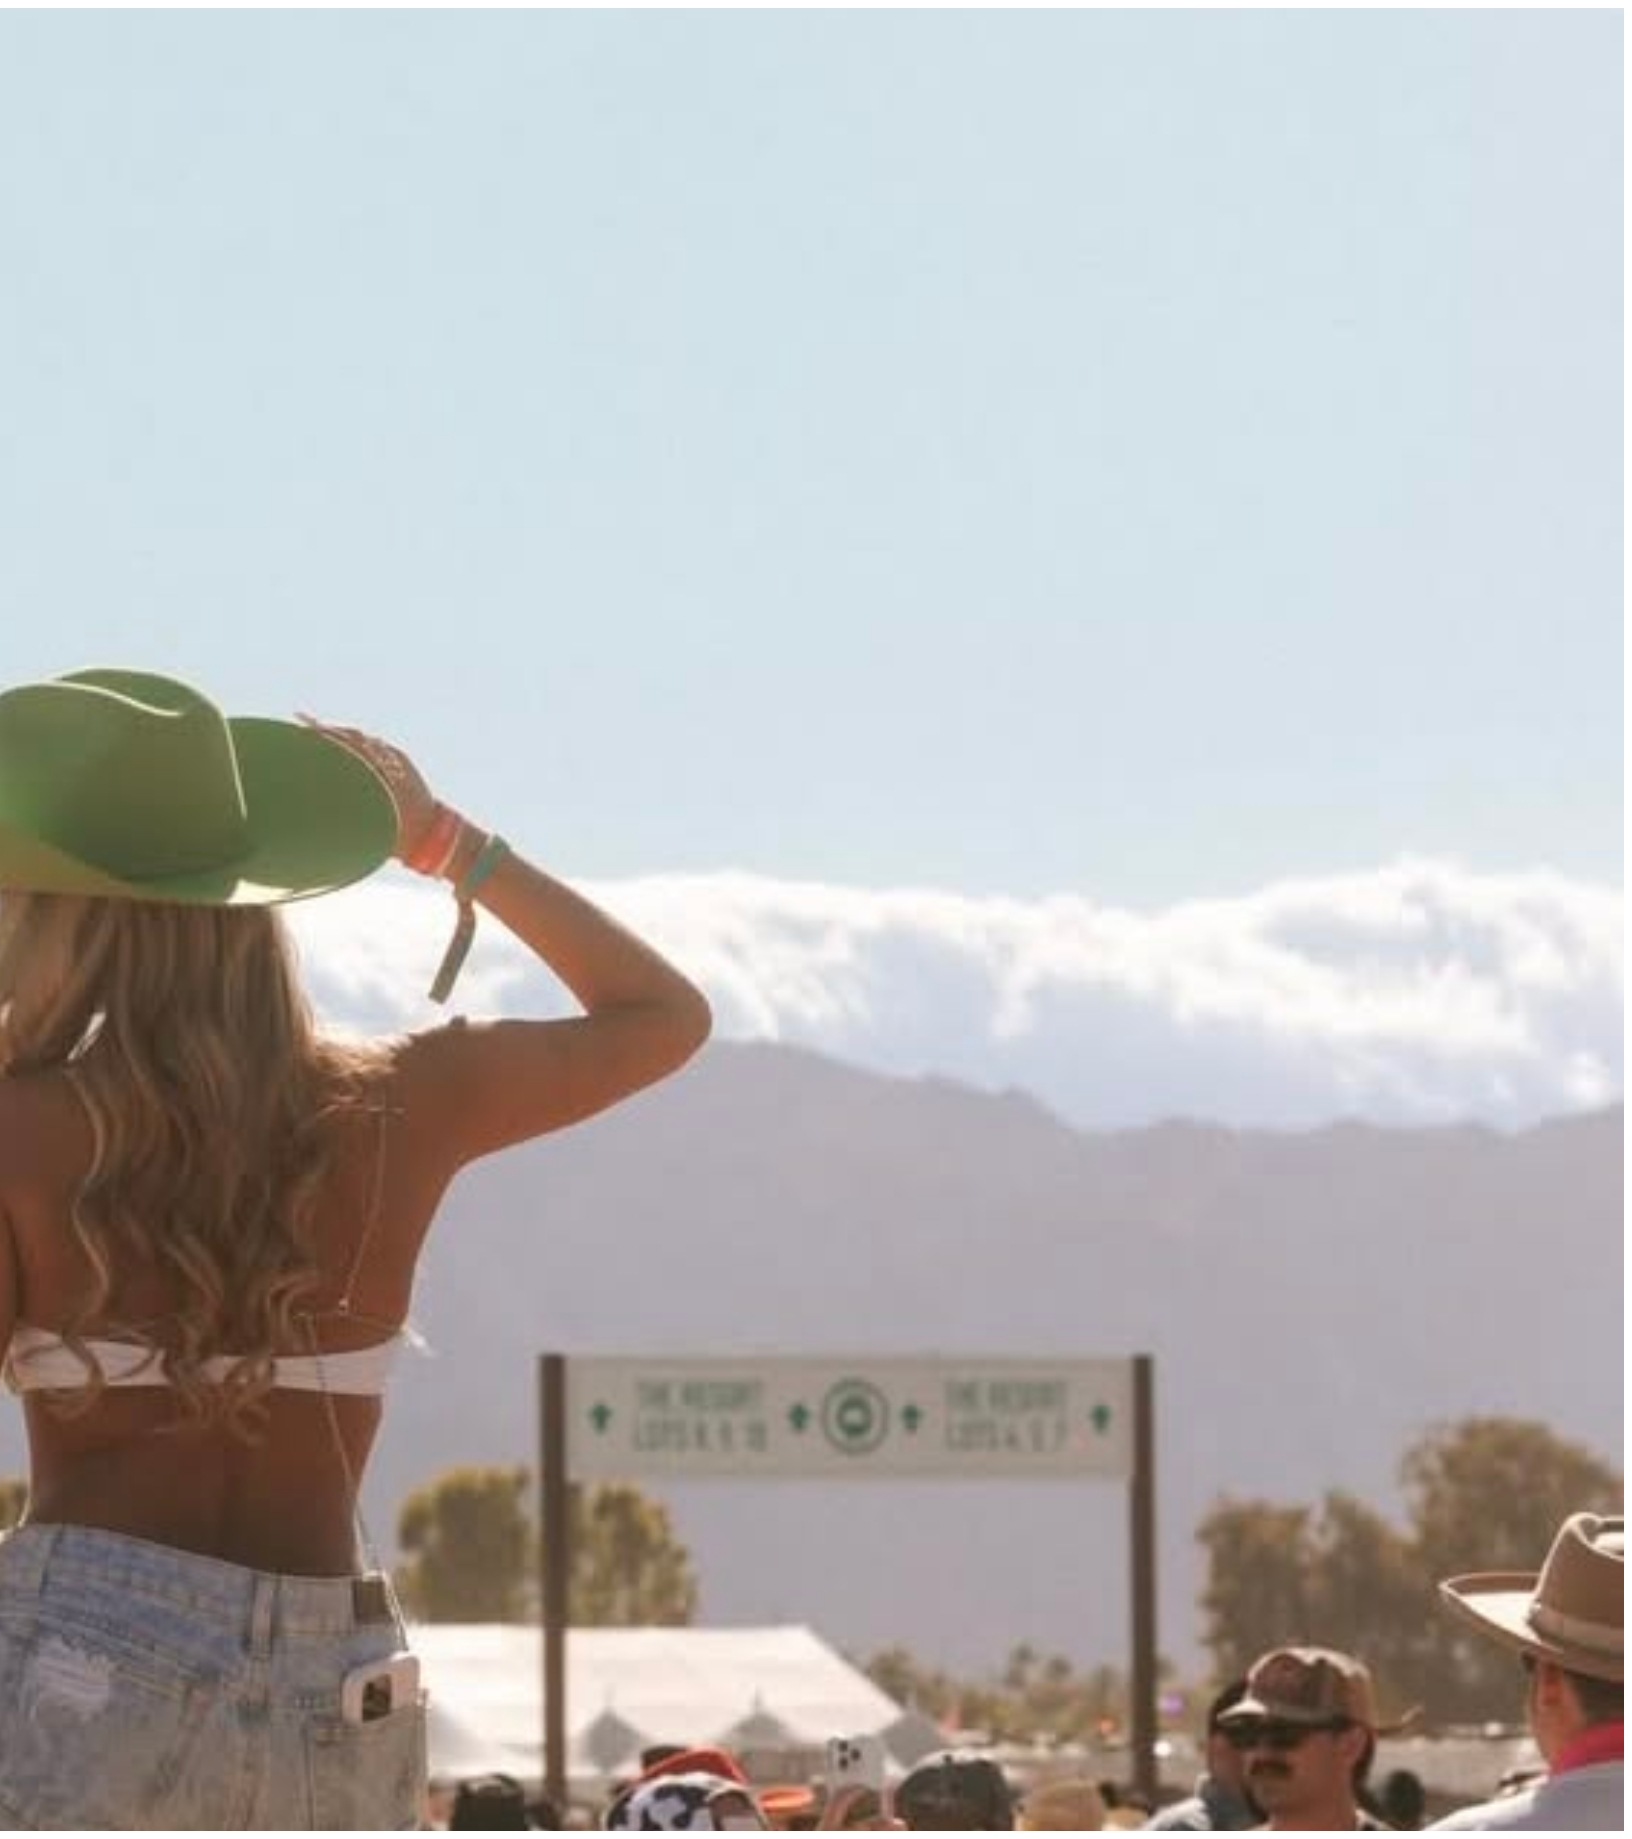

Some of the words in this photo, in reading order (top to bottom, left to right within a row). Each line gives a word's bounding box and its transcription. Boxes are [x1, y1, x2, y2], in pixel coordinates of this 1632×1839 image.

[637, 1381, 668, 1409] THE
[682, 1381, 763, 1410] RESORT
[945, 1381, 976, 1409] THE
[988, 1381, 1067, 1410] RESORT
